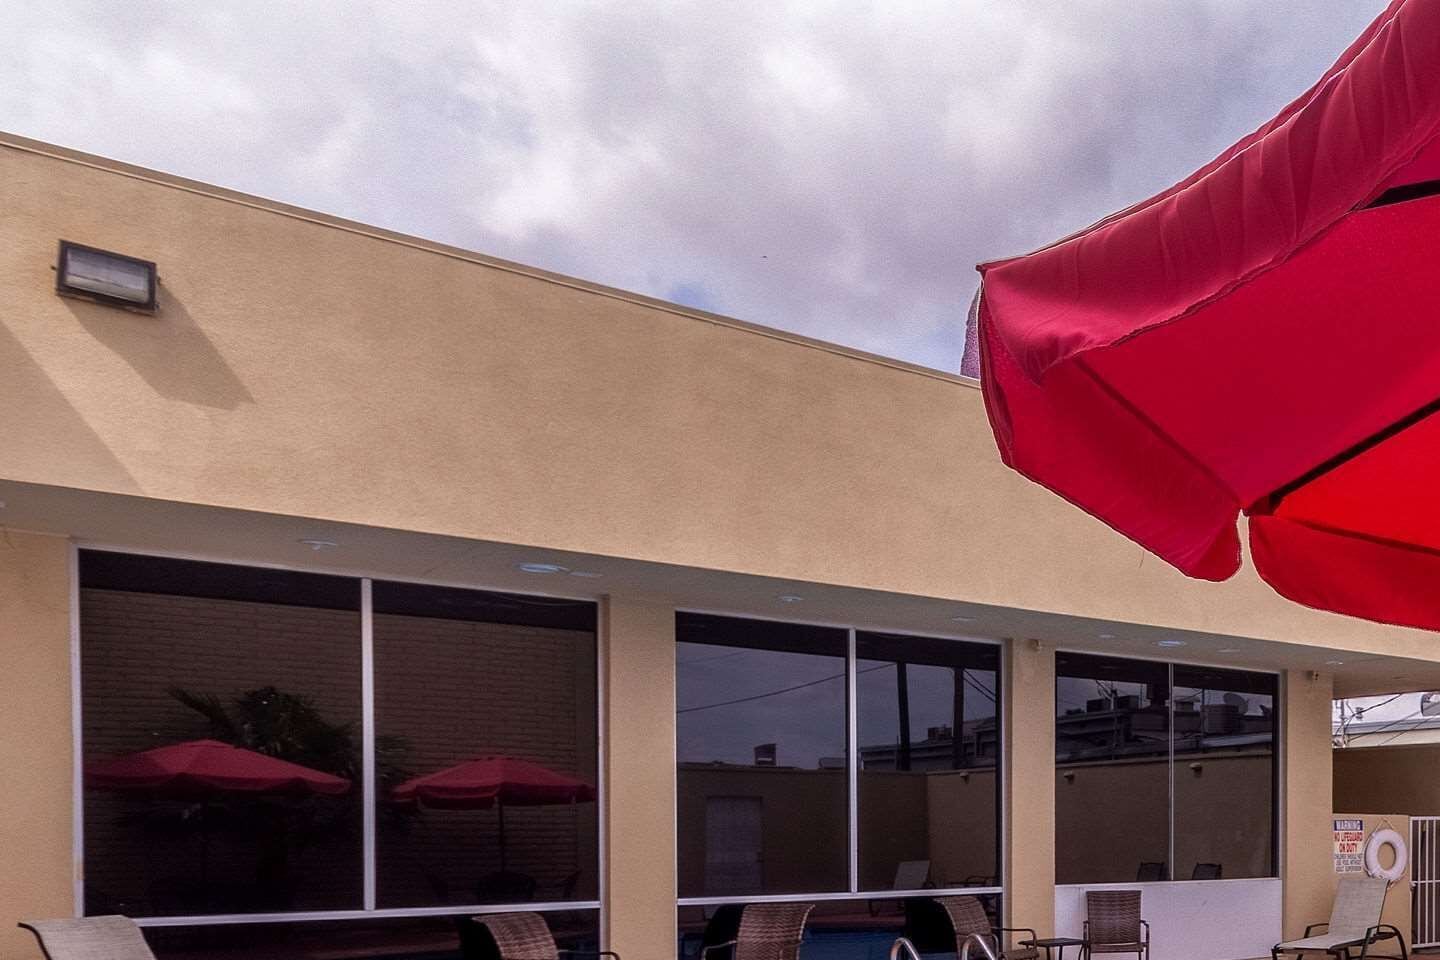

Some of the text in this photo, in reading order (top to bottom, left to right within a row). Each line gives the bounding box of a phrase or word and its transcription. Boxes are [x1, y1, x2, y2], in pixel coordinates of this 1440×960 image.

[1336, 820, 1361, 830] WARNING
[1334, 832, 1363, 841] NO LIFEGUARD
[1339, 843, 1357, 852] ON DUTY
